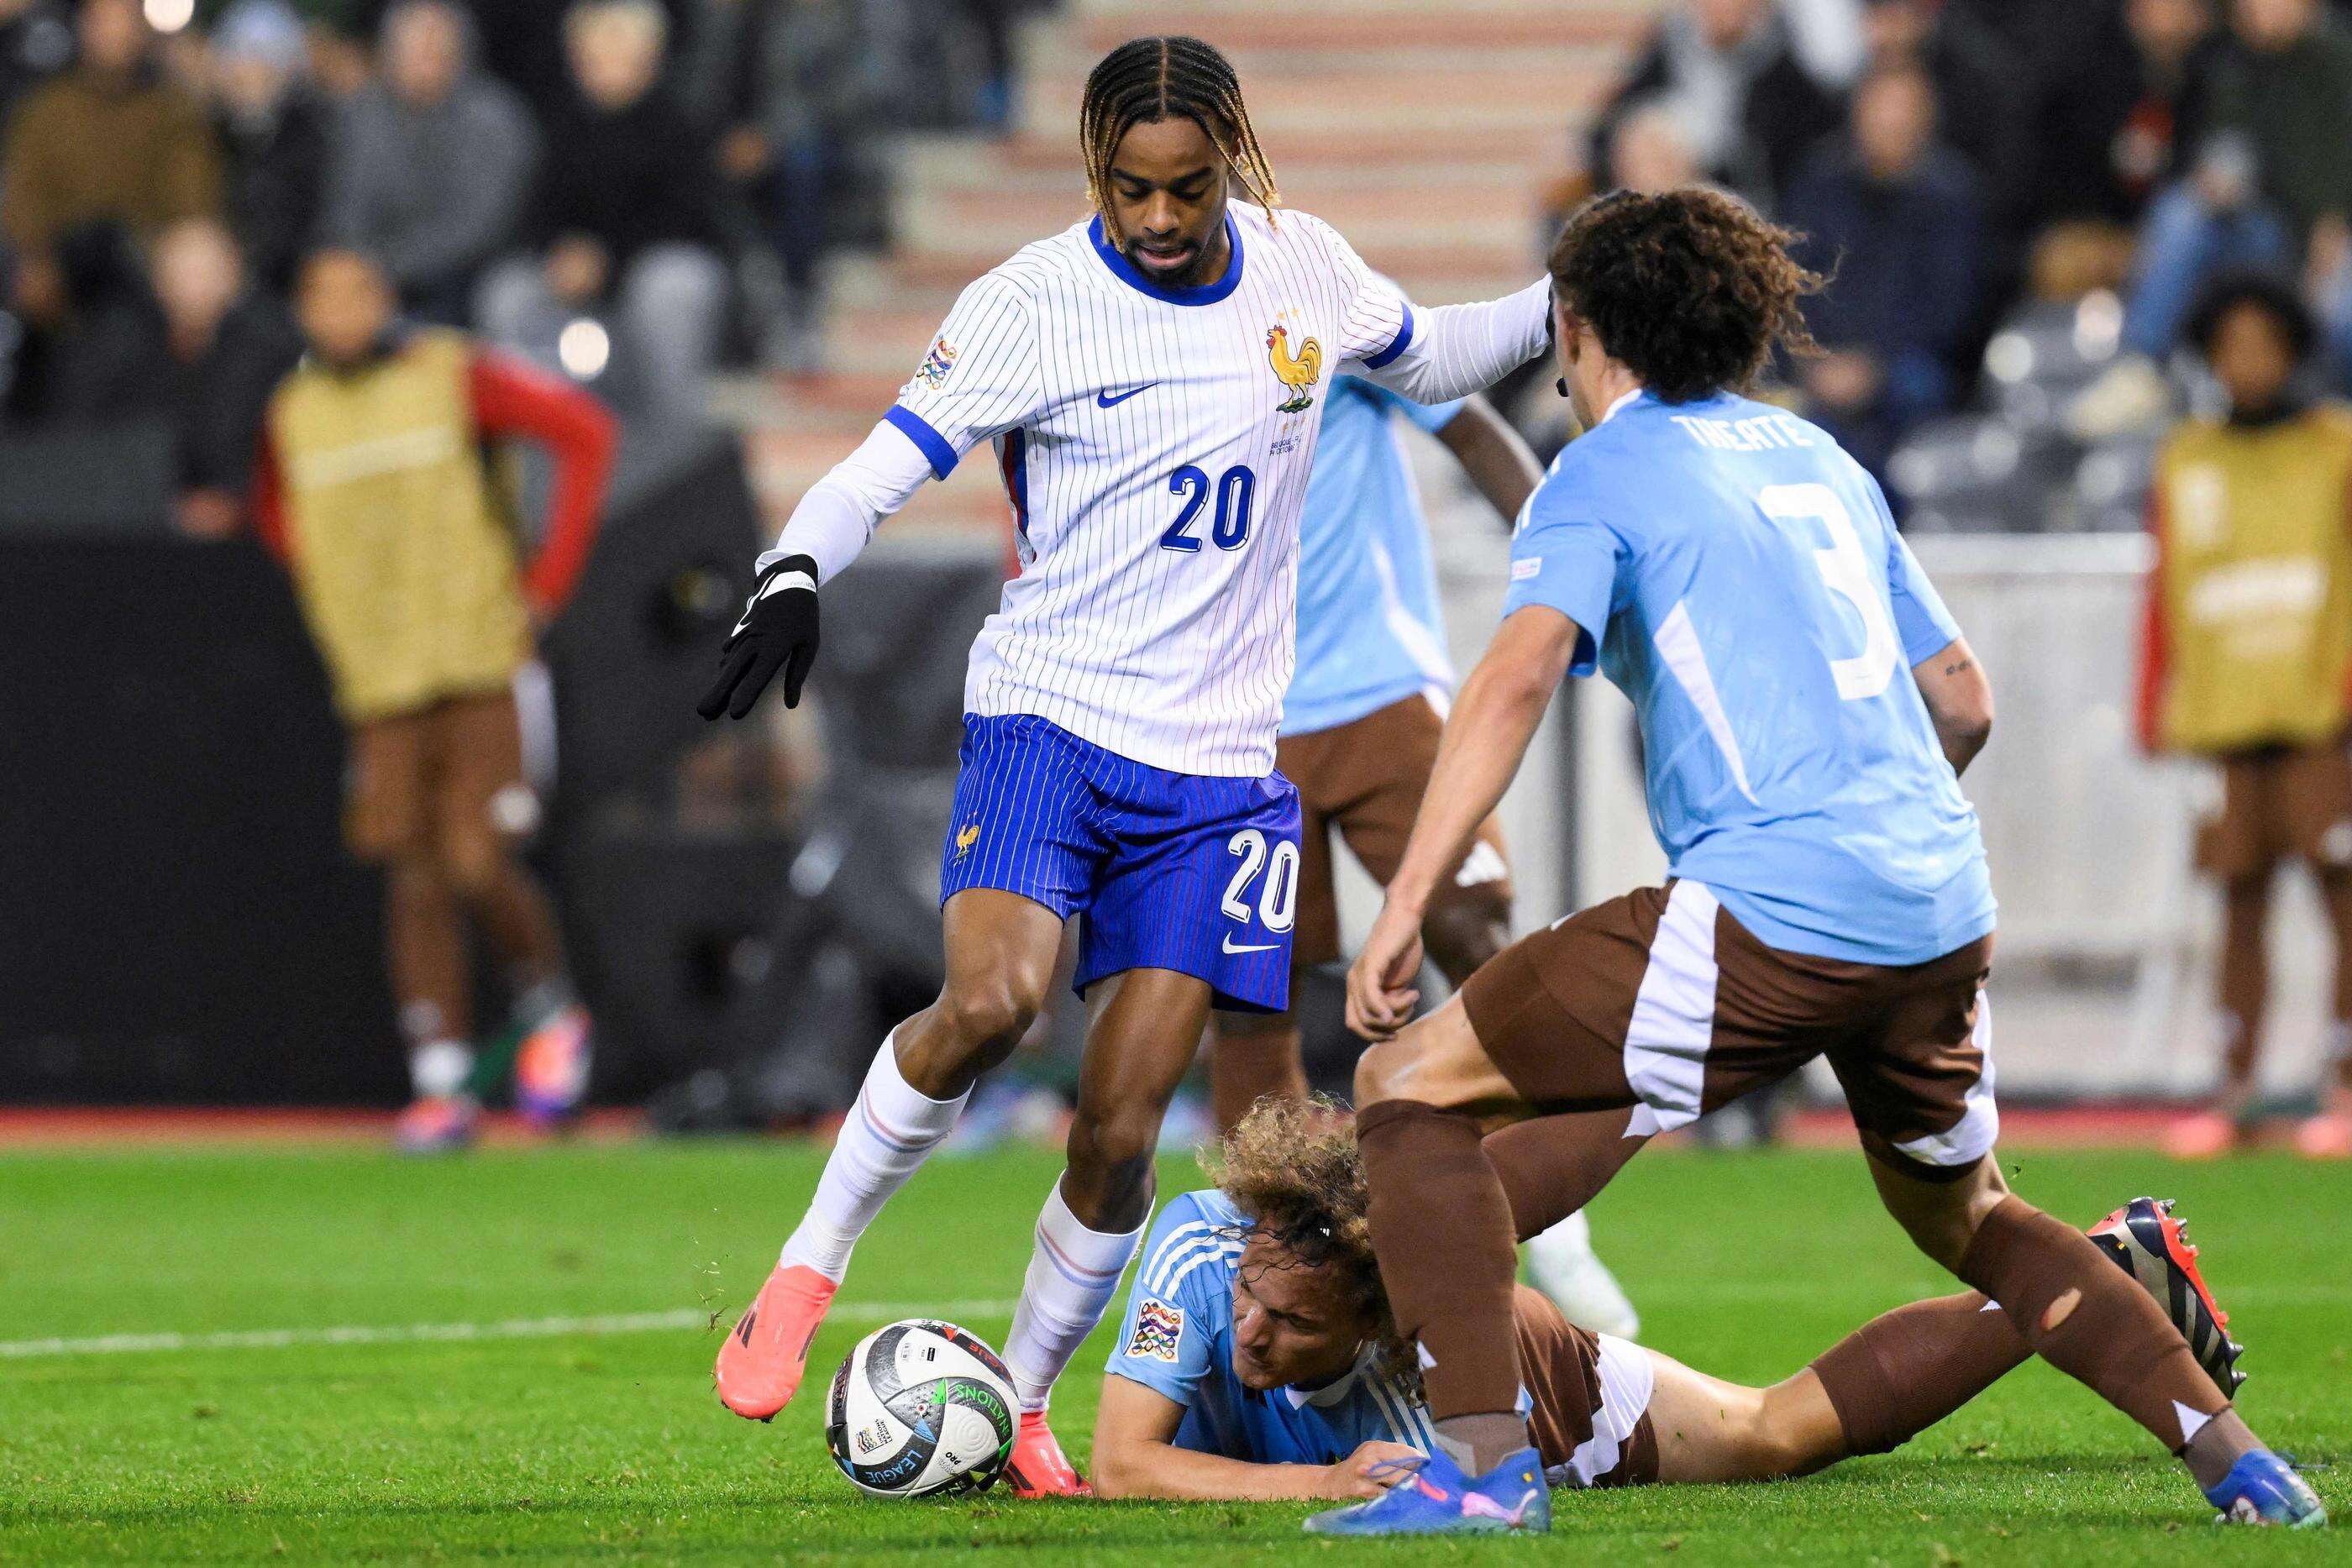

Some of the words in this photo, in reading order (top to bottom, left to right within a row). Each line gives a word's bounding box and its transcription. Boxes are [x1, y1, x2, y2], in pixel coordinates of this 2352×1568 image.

[1160, 464, 1256, 553] 20
[1757, 482, 1898, 701] 3
[1221, 828, 1301, 933] 20
[955, 1383, 1010, 1436] NATIONS
[865, 1449, 924, 1490] LEAGUE
[945, 1451, 962, 1466] PRO
